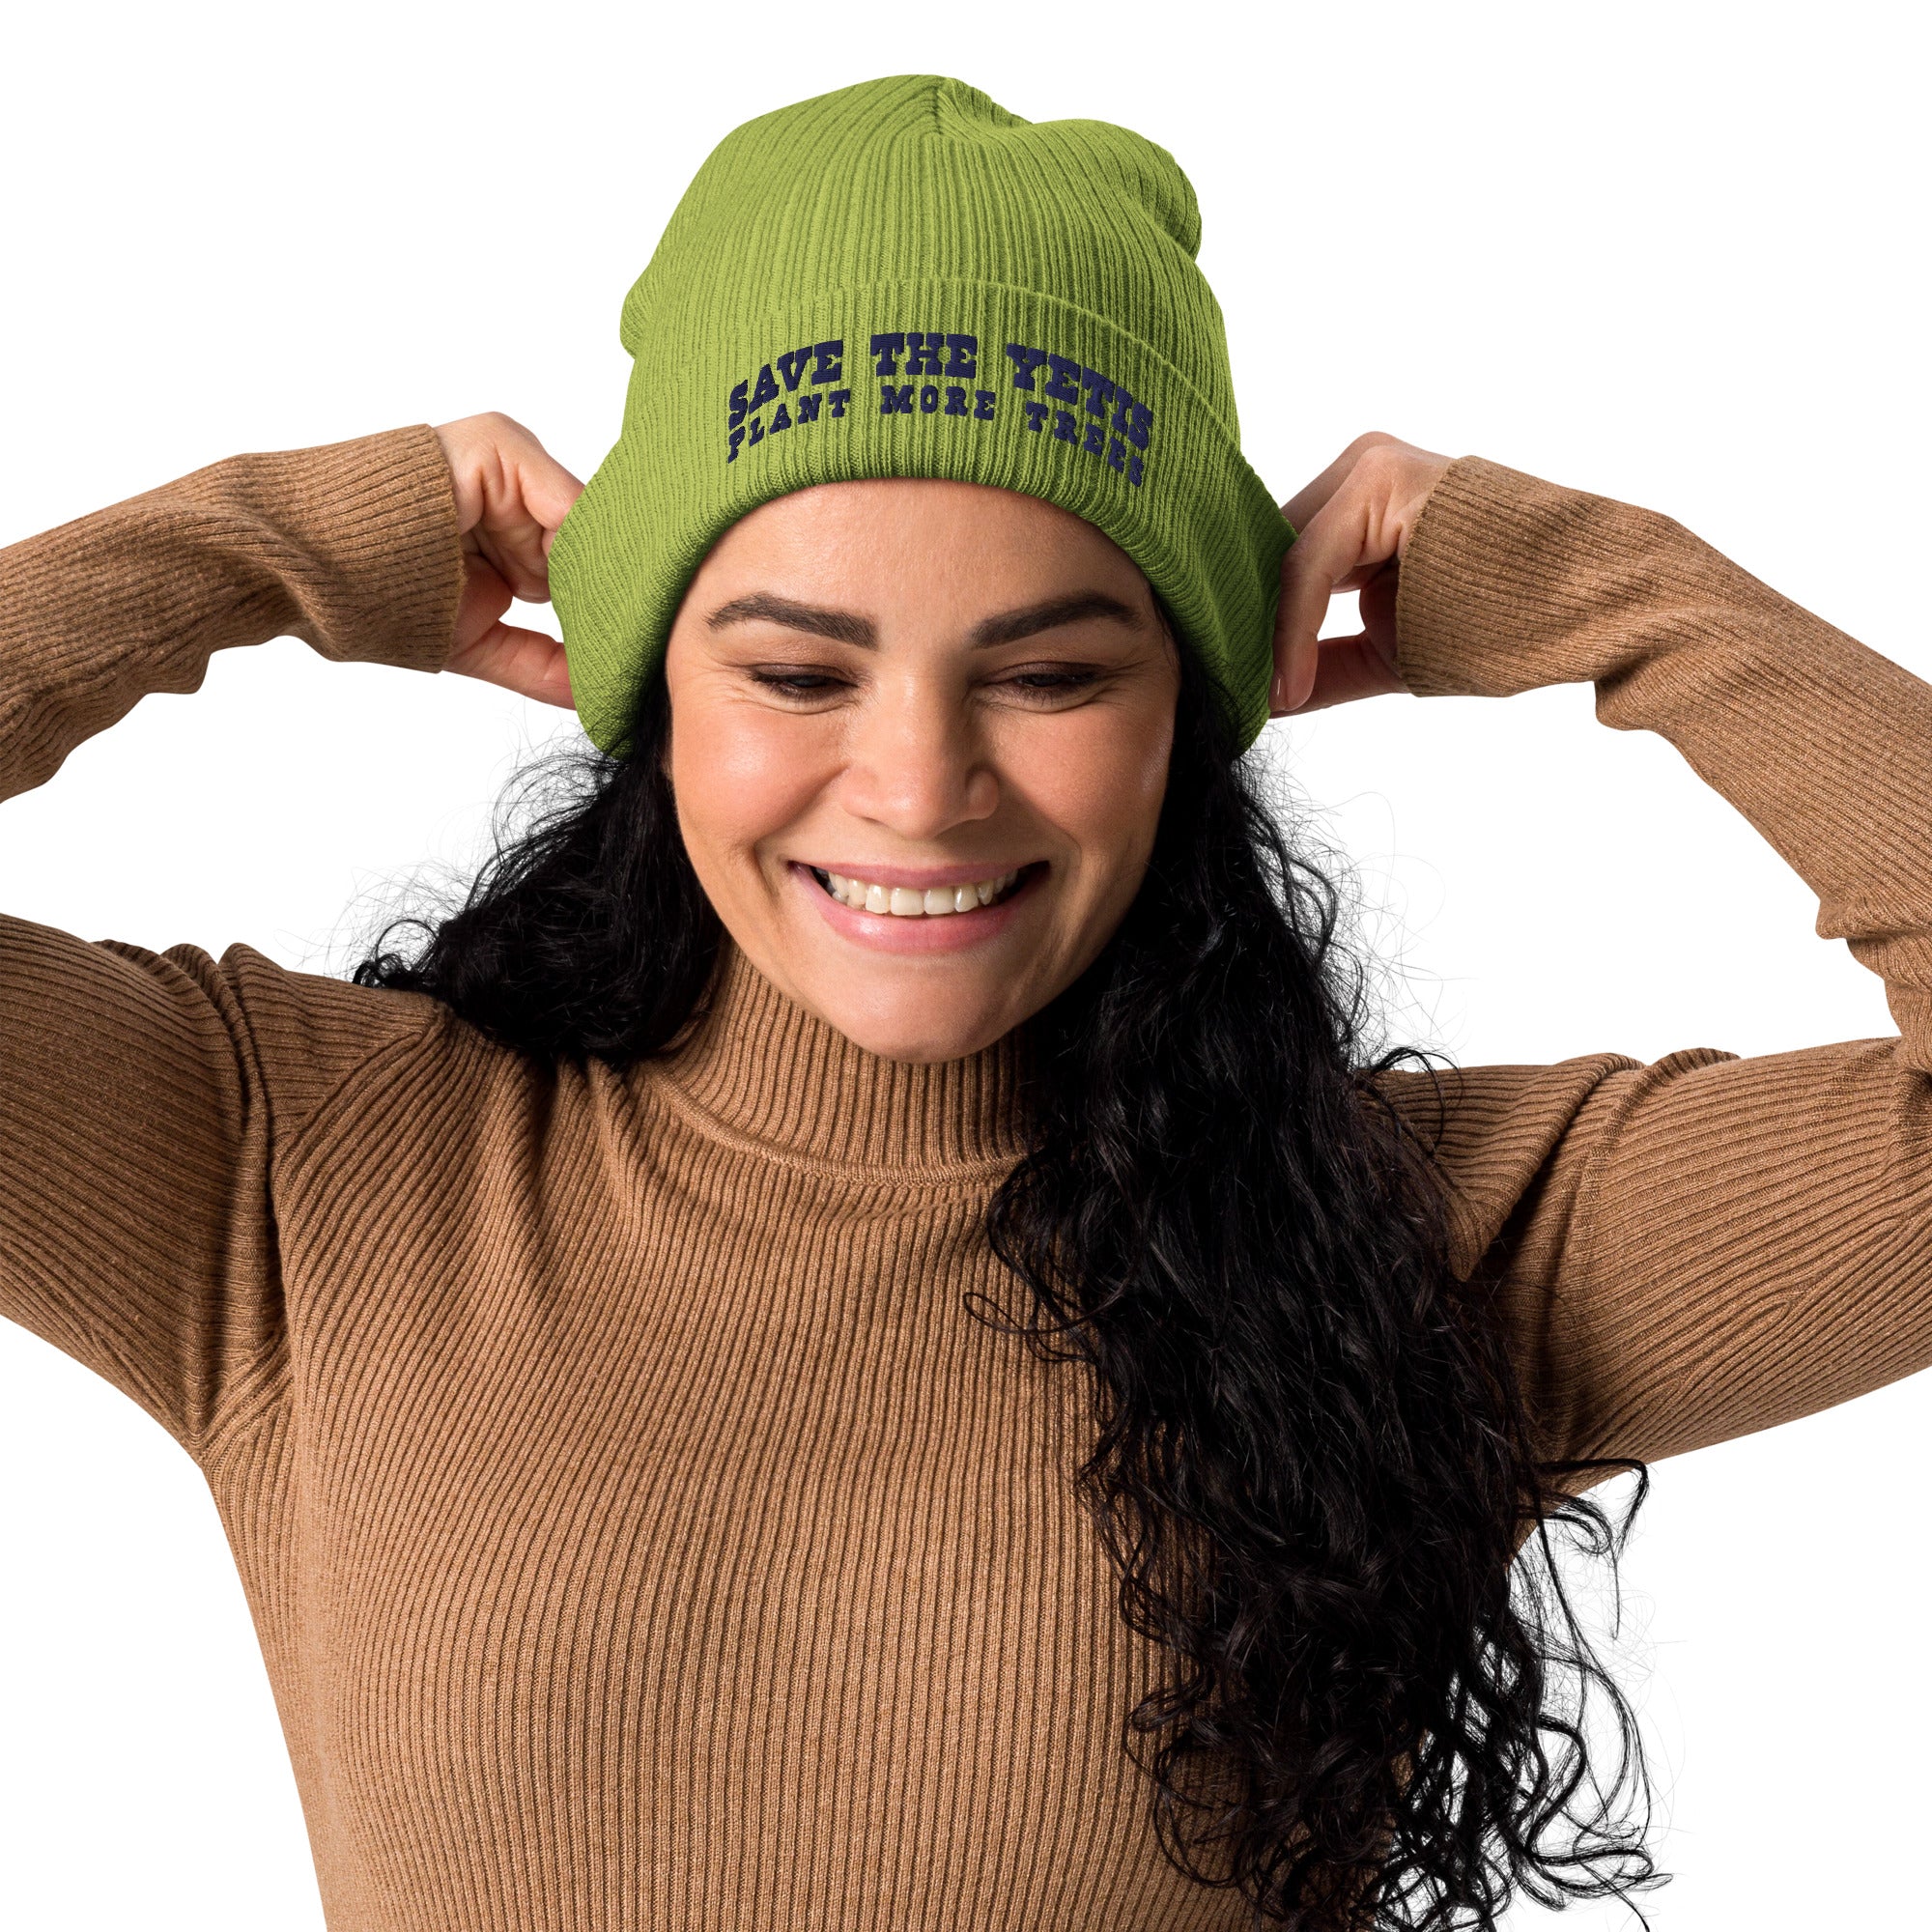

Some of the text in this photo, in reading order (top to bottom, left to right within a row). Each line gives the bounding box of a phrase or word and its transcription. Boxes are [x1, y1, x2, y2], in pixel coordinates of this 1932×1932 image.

[727, 385, 1144, 488] PLANT MORE TREES
[728, 332, 1153, 451] SAVE THE YETIS
